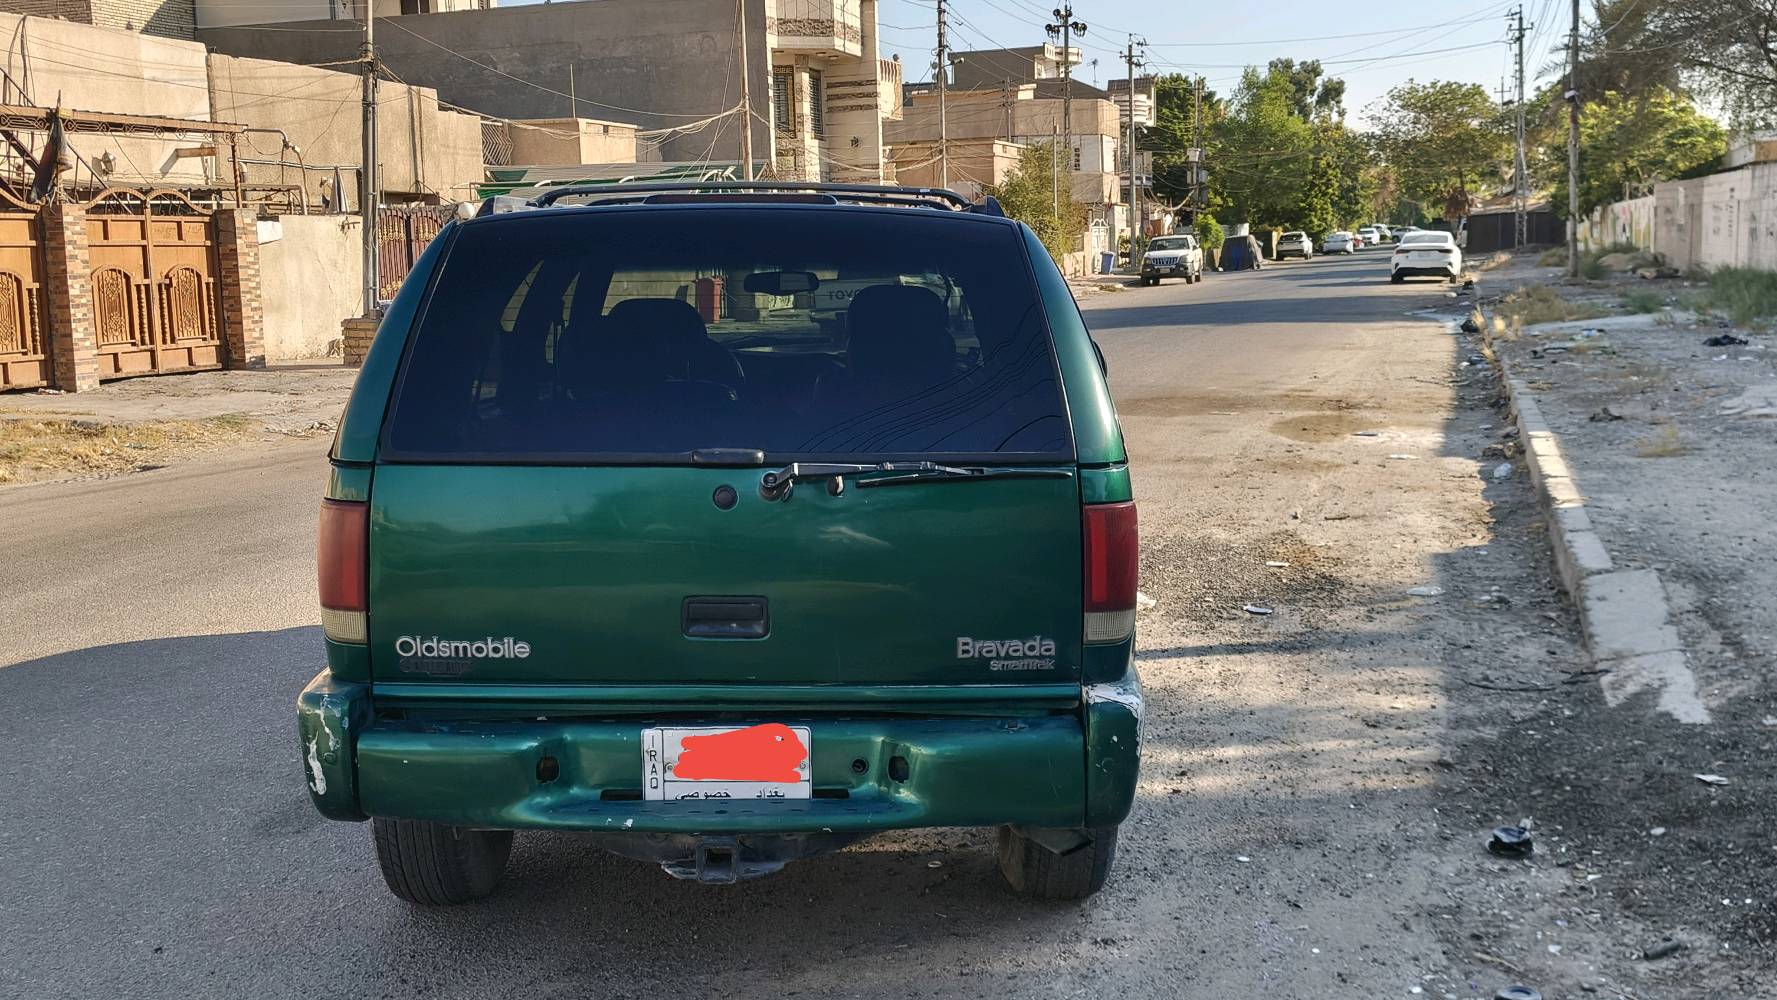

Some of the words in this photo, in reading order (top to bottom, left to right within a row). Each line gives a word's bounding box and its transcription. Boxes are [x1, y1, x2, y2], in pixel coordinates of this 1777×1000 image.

[395, 635, 531, 658] Oldsmobile
[956, 635, 1056, 658] Bravada
[649, 735, 659, 789] IRAQ
[755, 786, 785, 798] بغداد
